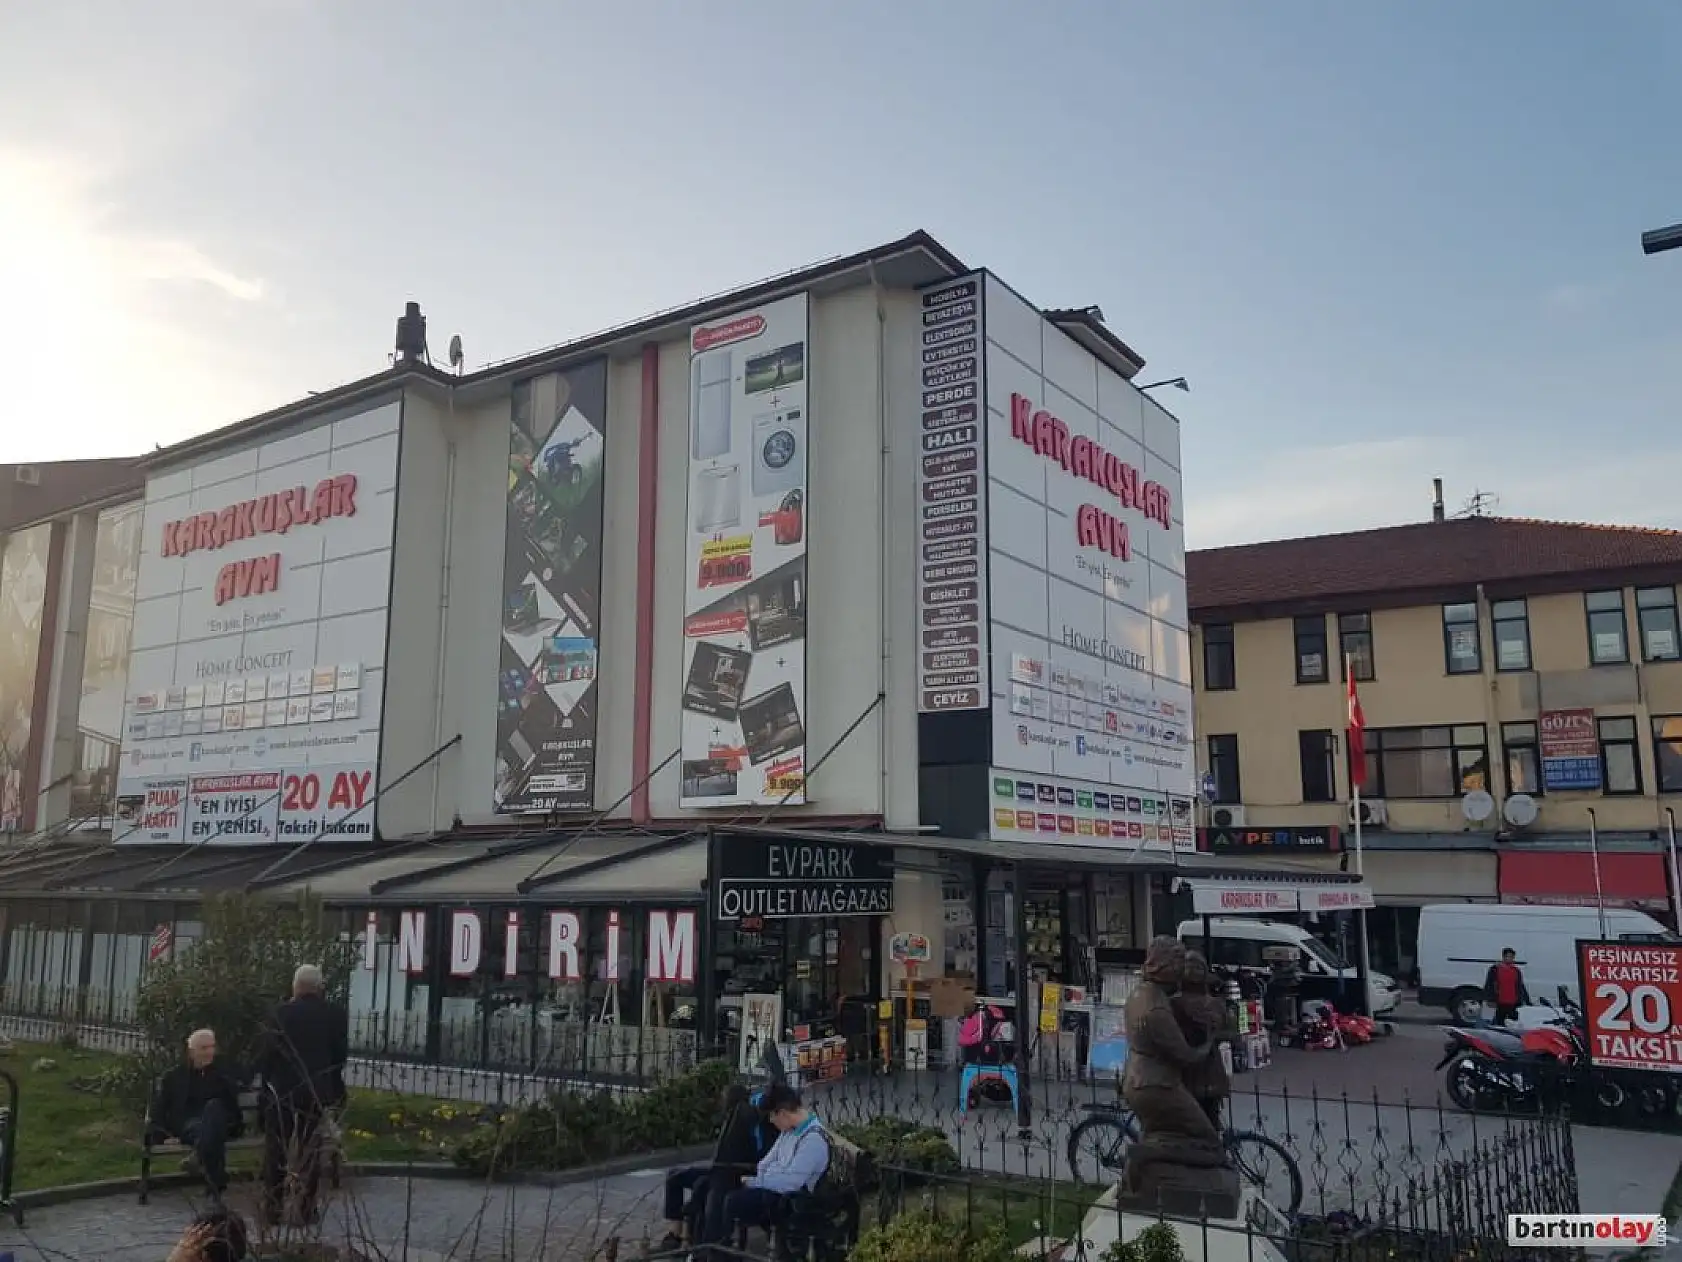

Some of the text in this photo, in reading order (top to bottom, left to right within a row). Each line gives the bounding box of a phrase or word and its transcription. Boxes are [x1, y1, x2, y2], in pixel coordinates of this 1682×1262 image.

[927, 386, 973, 405] PERDE
[927, 428, 971, 449] HALI
[1011, 392, 1172, 530] KARAKUŞLAR
[161, 473, 358, 557] KARAKUŞLAR
[1077, 503, 1131, 562] AVM
[214, 553, 282, 606] AVM
[933, 690, 970, 708] ÇEYİZ
[282, 770, 372, 810] 20 AY
[201, 800, 224, 815] EN
[191, 821, 216, 836] EN
[278, 819, 318, 834] Taksit
[768, 845, 855, 877] EVPARK
[723, 884, 893, 915] OUTLET MAĞAZASI
[1588, 947, 1679, 965] PEŞİNATSIZ
[1591, 966, 1680, 984] K.KARTSIZ
[1595, 983, 1672, 1034] 20
